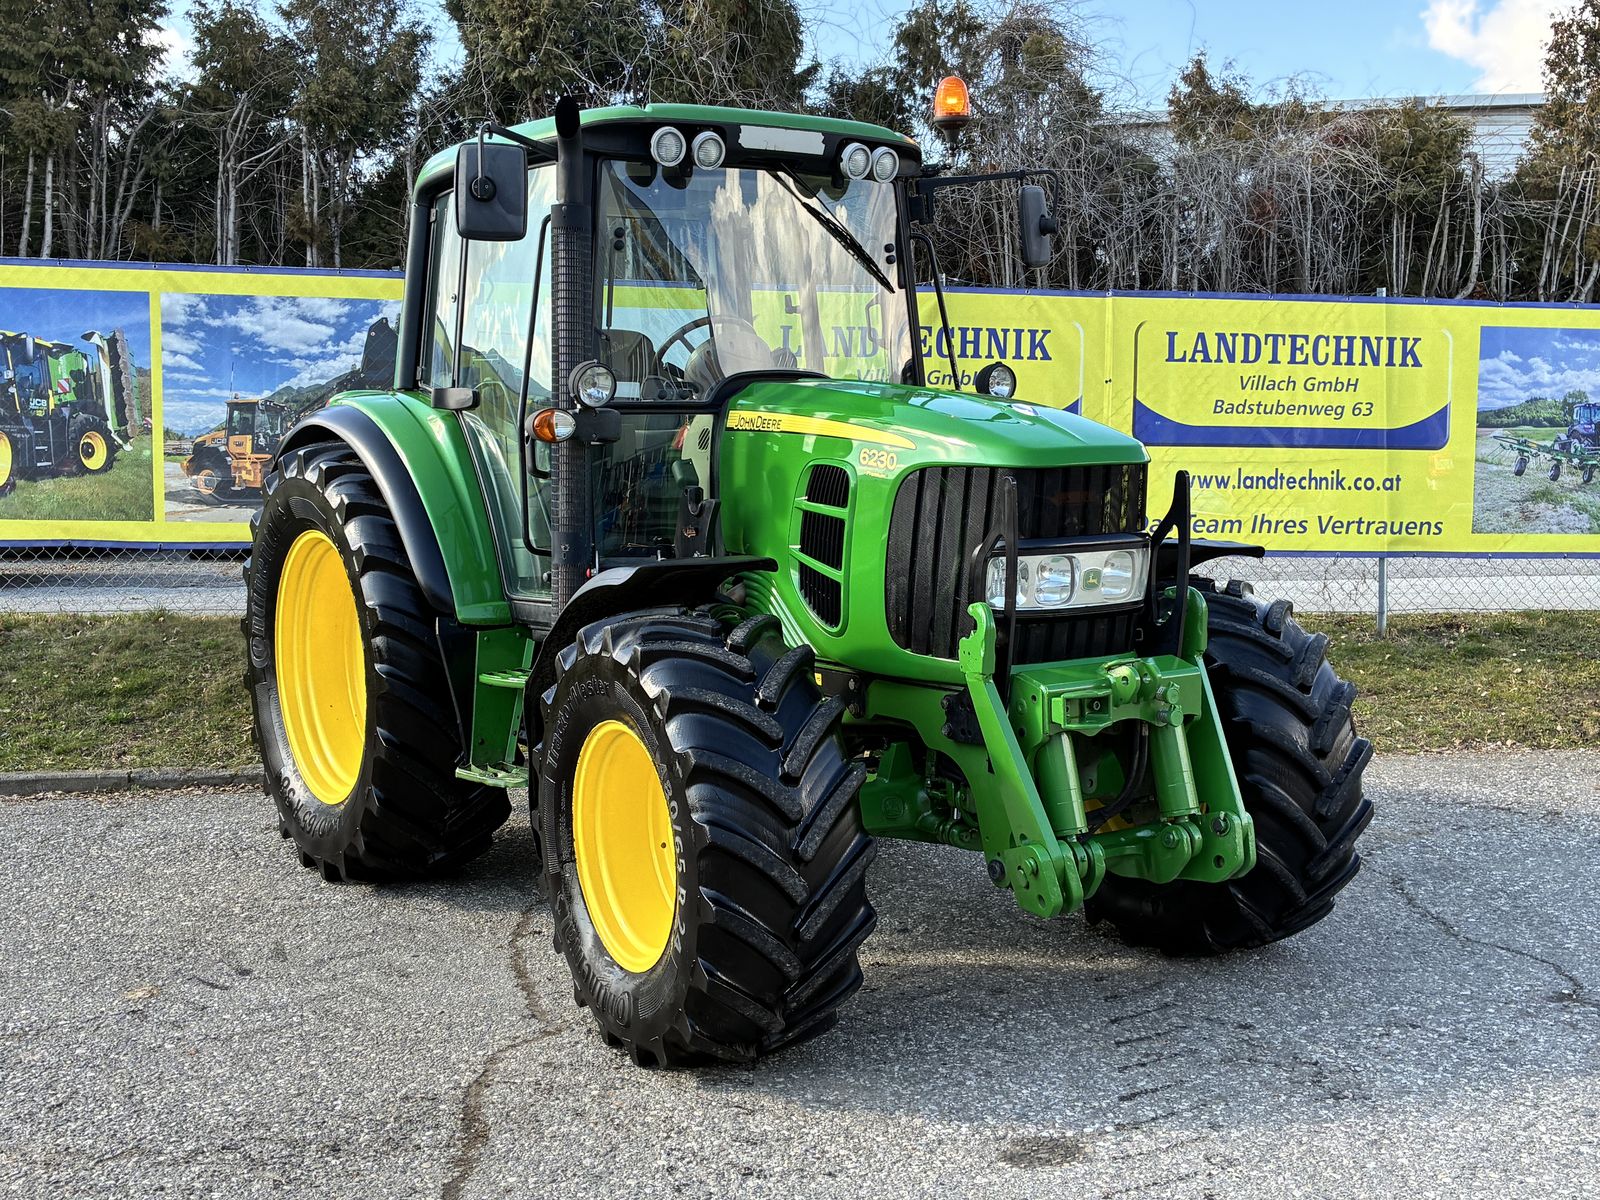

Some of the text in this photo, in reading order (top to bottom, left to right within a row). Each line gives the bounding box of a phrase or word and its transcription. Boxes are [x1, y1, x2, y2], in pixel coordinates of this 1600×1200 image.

[779, 325, 1053, 361] LNDECHNIK
[1165, 331, 1422, 367] LANDTECHNIK
[1240, 376, 1359, 392] Villach GmbH
[1213, 399, 1374, 419] Badstubenweg 63
[859, 447, 897, 470] 6230
[1190, 514, 1242, 534] eam
[1251, 513, 1308, 535] Ihres
[1317, 515, 1444, 535] Vertrauens
[677, 888, 687, 906] R
